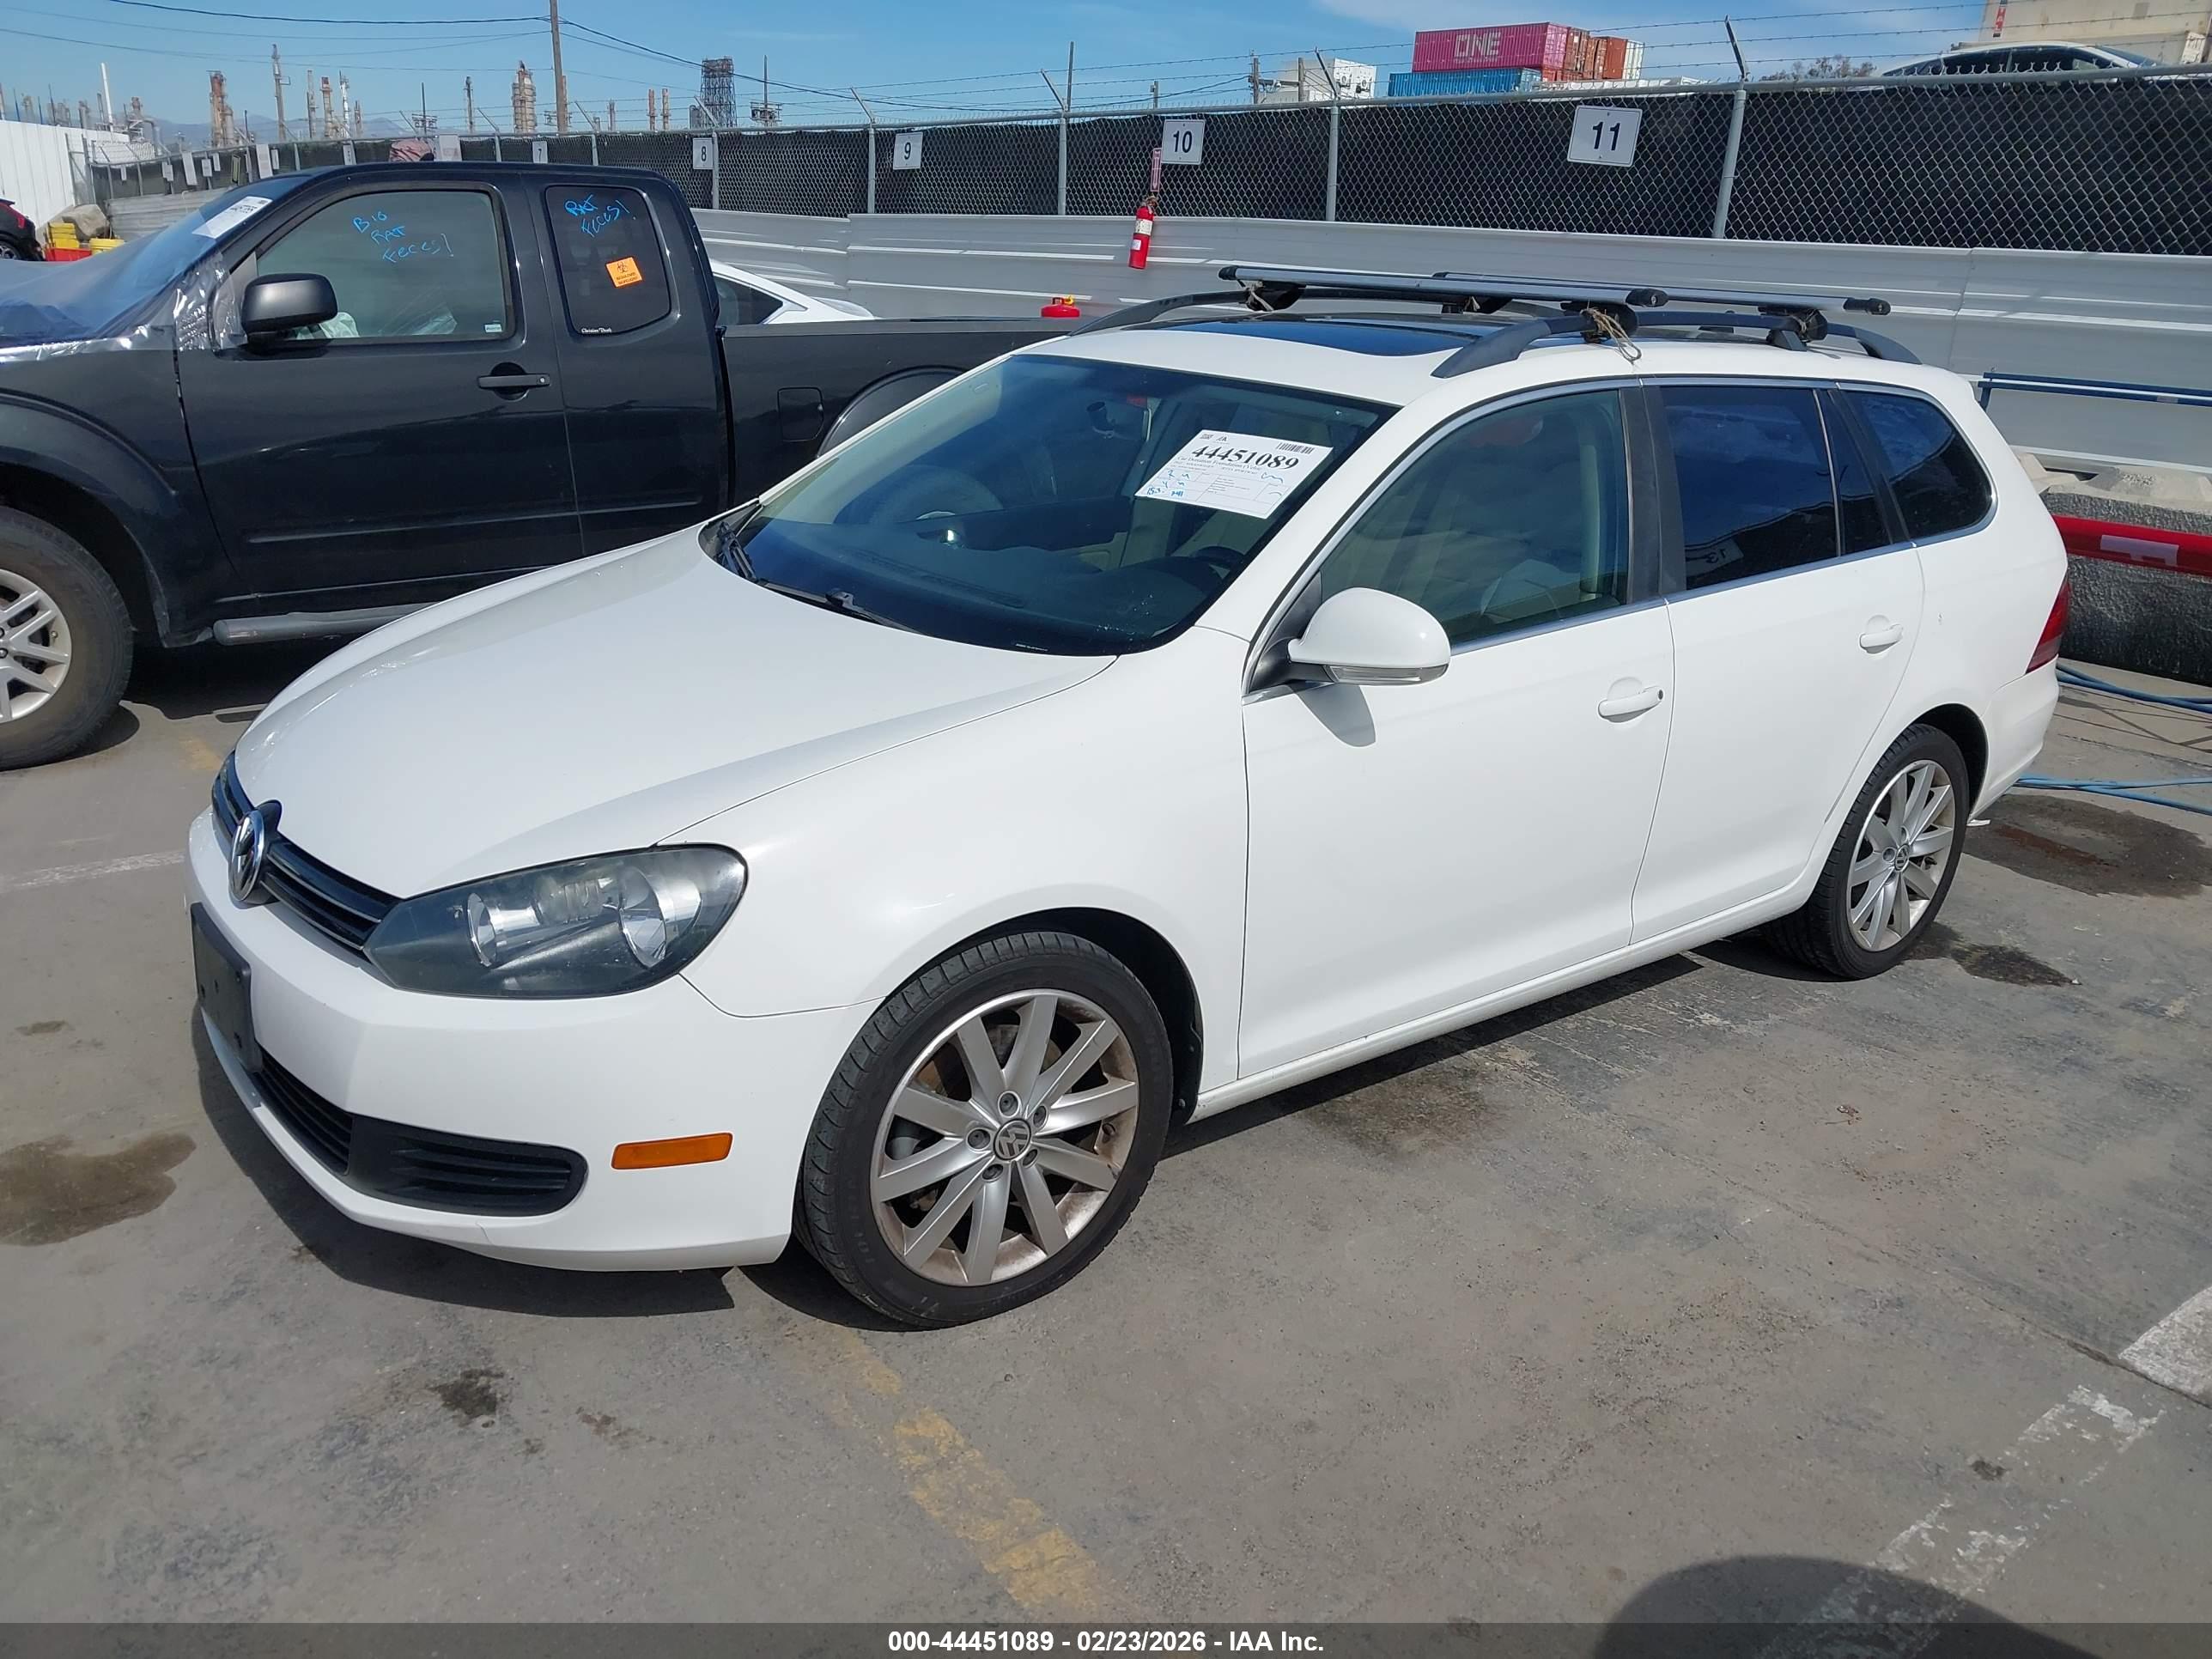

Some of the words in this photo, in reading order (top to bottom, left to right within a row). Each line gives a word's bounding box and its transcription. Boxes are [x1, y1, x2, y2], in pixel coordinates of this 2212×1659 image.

[1455, 32, 1500, 58] ONE
[1173, 130, 1194, 154] 10
[1592, 121, 1621, 151] 11
[701, 146, 707, 161] 8
[904, 142, 912, 160] 9
[370, 226, 406, 245] RAT
[1192, 445, 1299, 470] 44451089
